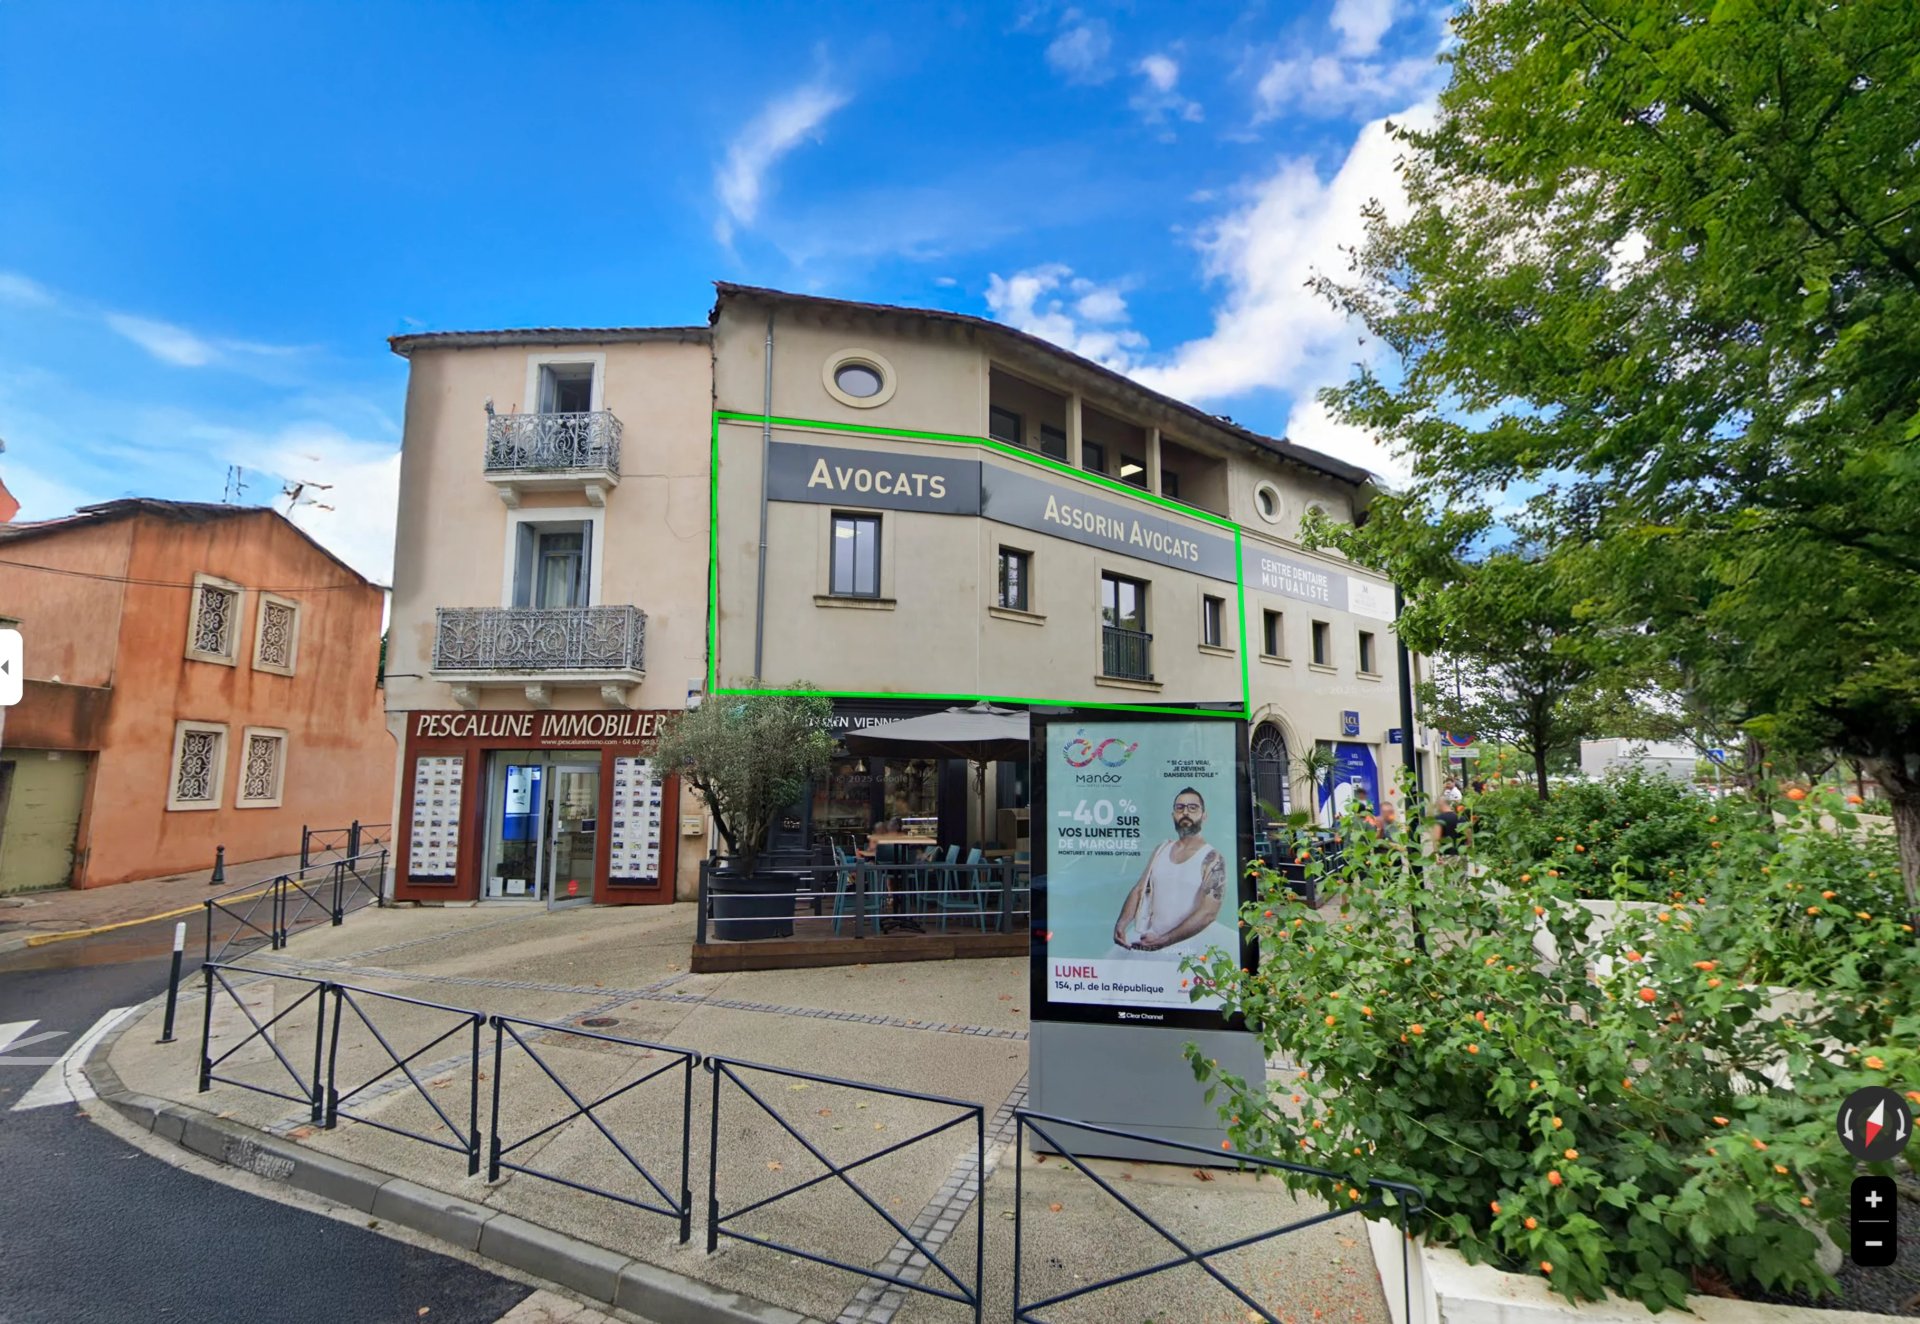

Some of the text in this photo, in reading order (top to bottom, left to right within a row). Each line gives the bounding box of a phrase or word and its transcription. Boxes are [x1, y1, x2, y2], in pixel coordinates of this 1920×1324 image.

[1261, 558, 1328, 588] CENTRE DENTAIRE
[1262, 572, 1329, 602] MUTUALISTE
[416, 714, 666, 737] PESCALUNE IMMOBILIER
[854, 717, 905, 727] VIENN
[1345, 716, 1358, 725] LCL
[1116, 816, 1140, 826] SUR
[1058, 828, 1140, 838] VOS LUNETTES
[1058, 839, 1138, 850] DE MARQUES
[1055, 965, 1098, 978] LUNEL
[1055, 981, 1164, 994] 154, pl. de la République
